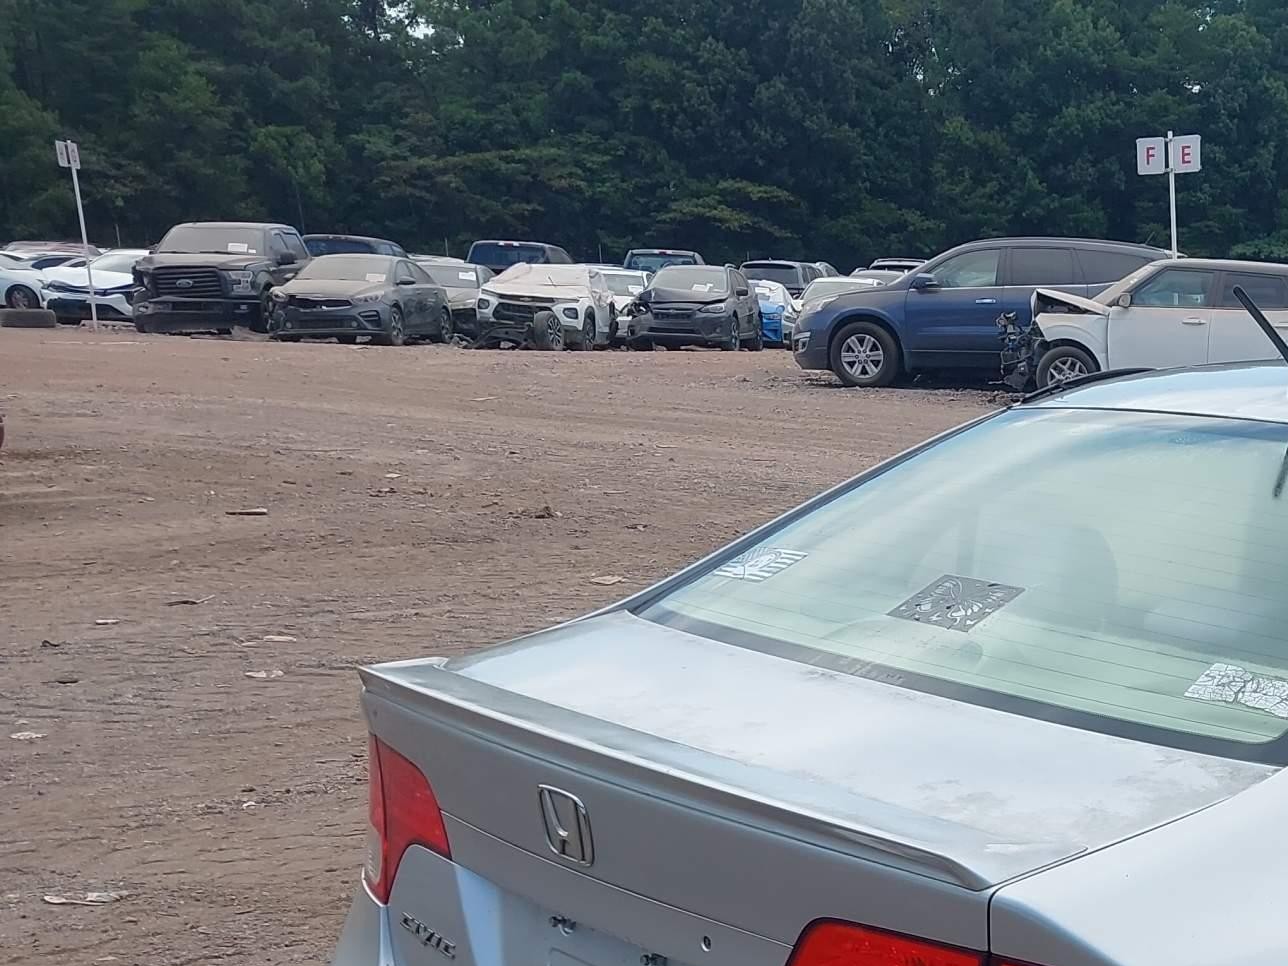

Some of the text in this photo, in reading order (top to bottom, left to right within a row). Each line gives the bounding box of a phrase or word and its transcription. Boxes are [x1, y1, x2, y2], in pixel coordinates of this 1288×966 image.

[1145, 146, 1156, 166] F
[1181, 145, 1192, 165] E
[400, 911, 457, 960] CIVIC
